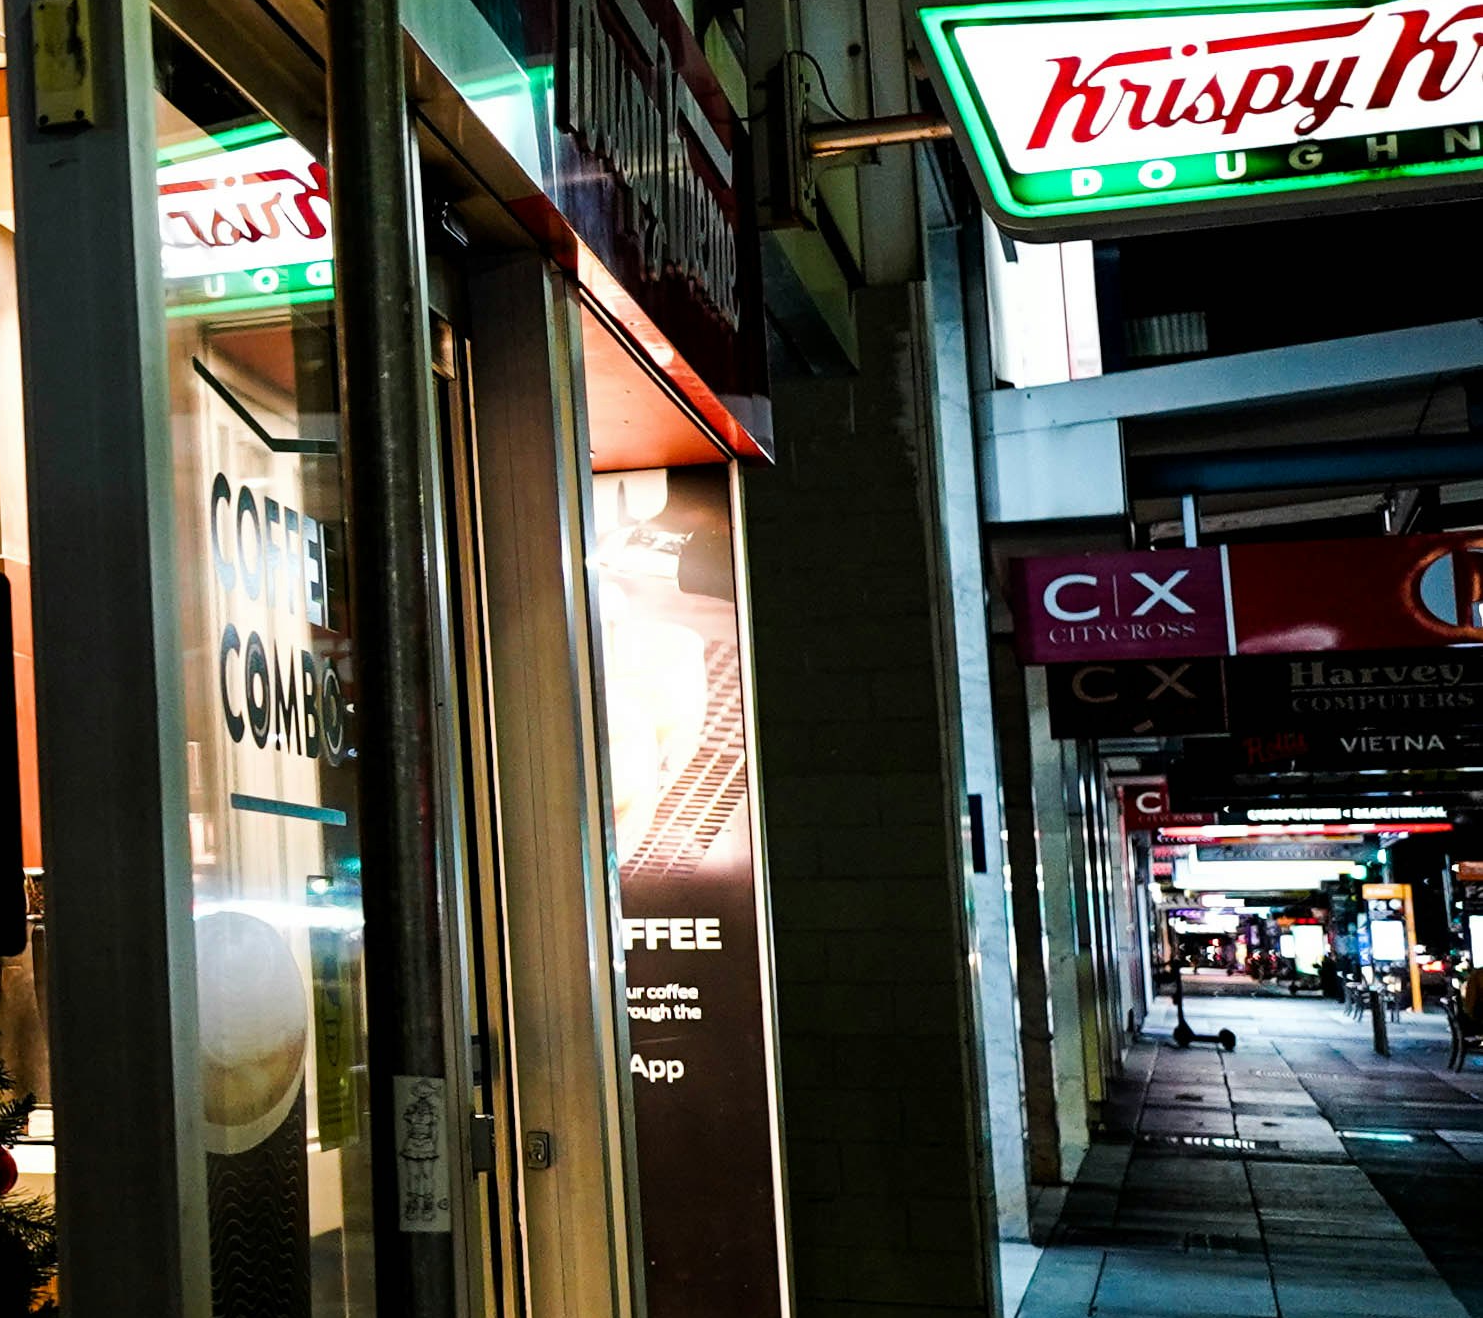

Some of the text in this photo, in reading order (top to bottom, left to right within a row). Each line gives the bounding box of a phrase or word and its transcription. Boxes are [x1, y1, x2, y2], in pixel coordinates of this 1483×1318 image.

[1025, 12, 1375, 151] Krispy
[1070, 126, 1483, 197] DOUGHN
[1048, 620, 1197, 645] CITYCROSS
[1289, 660, 1465, 687] Harvey
[220, 622, 344, 768] COMBO
[1290, 691, 1480, 713] COMPUTERS
[621, 918, 722, 950] FFEE
[646, 983, 699, 1000] coffee
[627, 1003, 702, 1023] rough the
[630, 1053, 685, 1083] App
